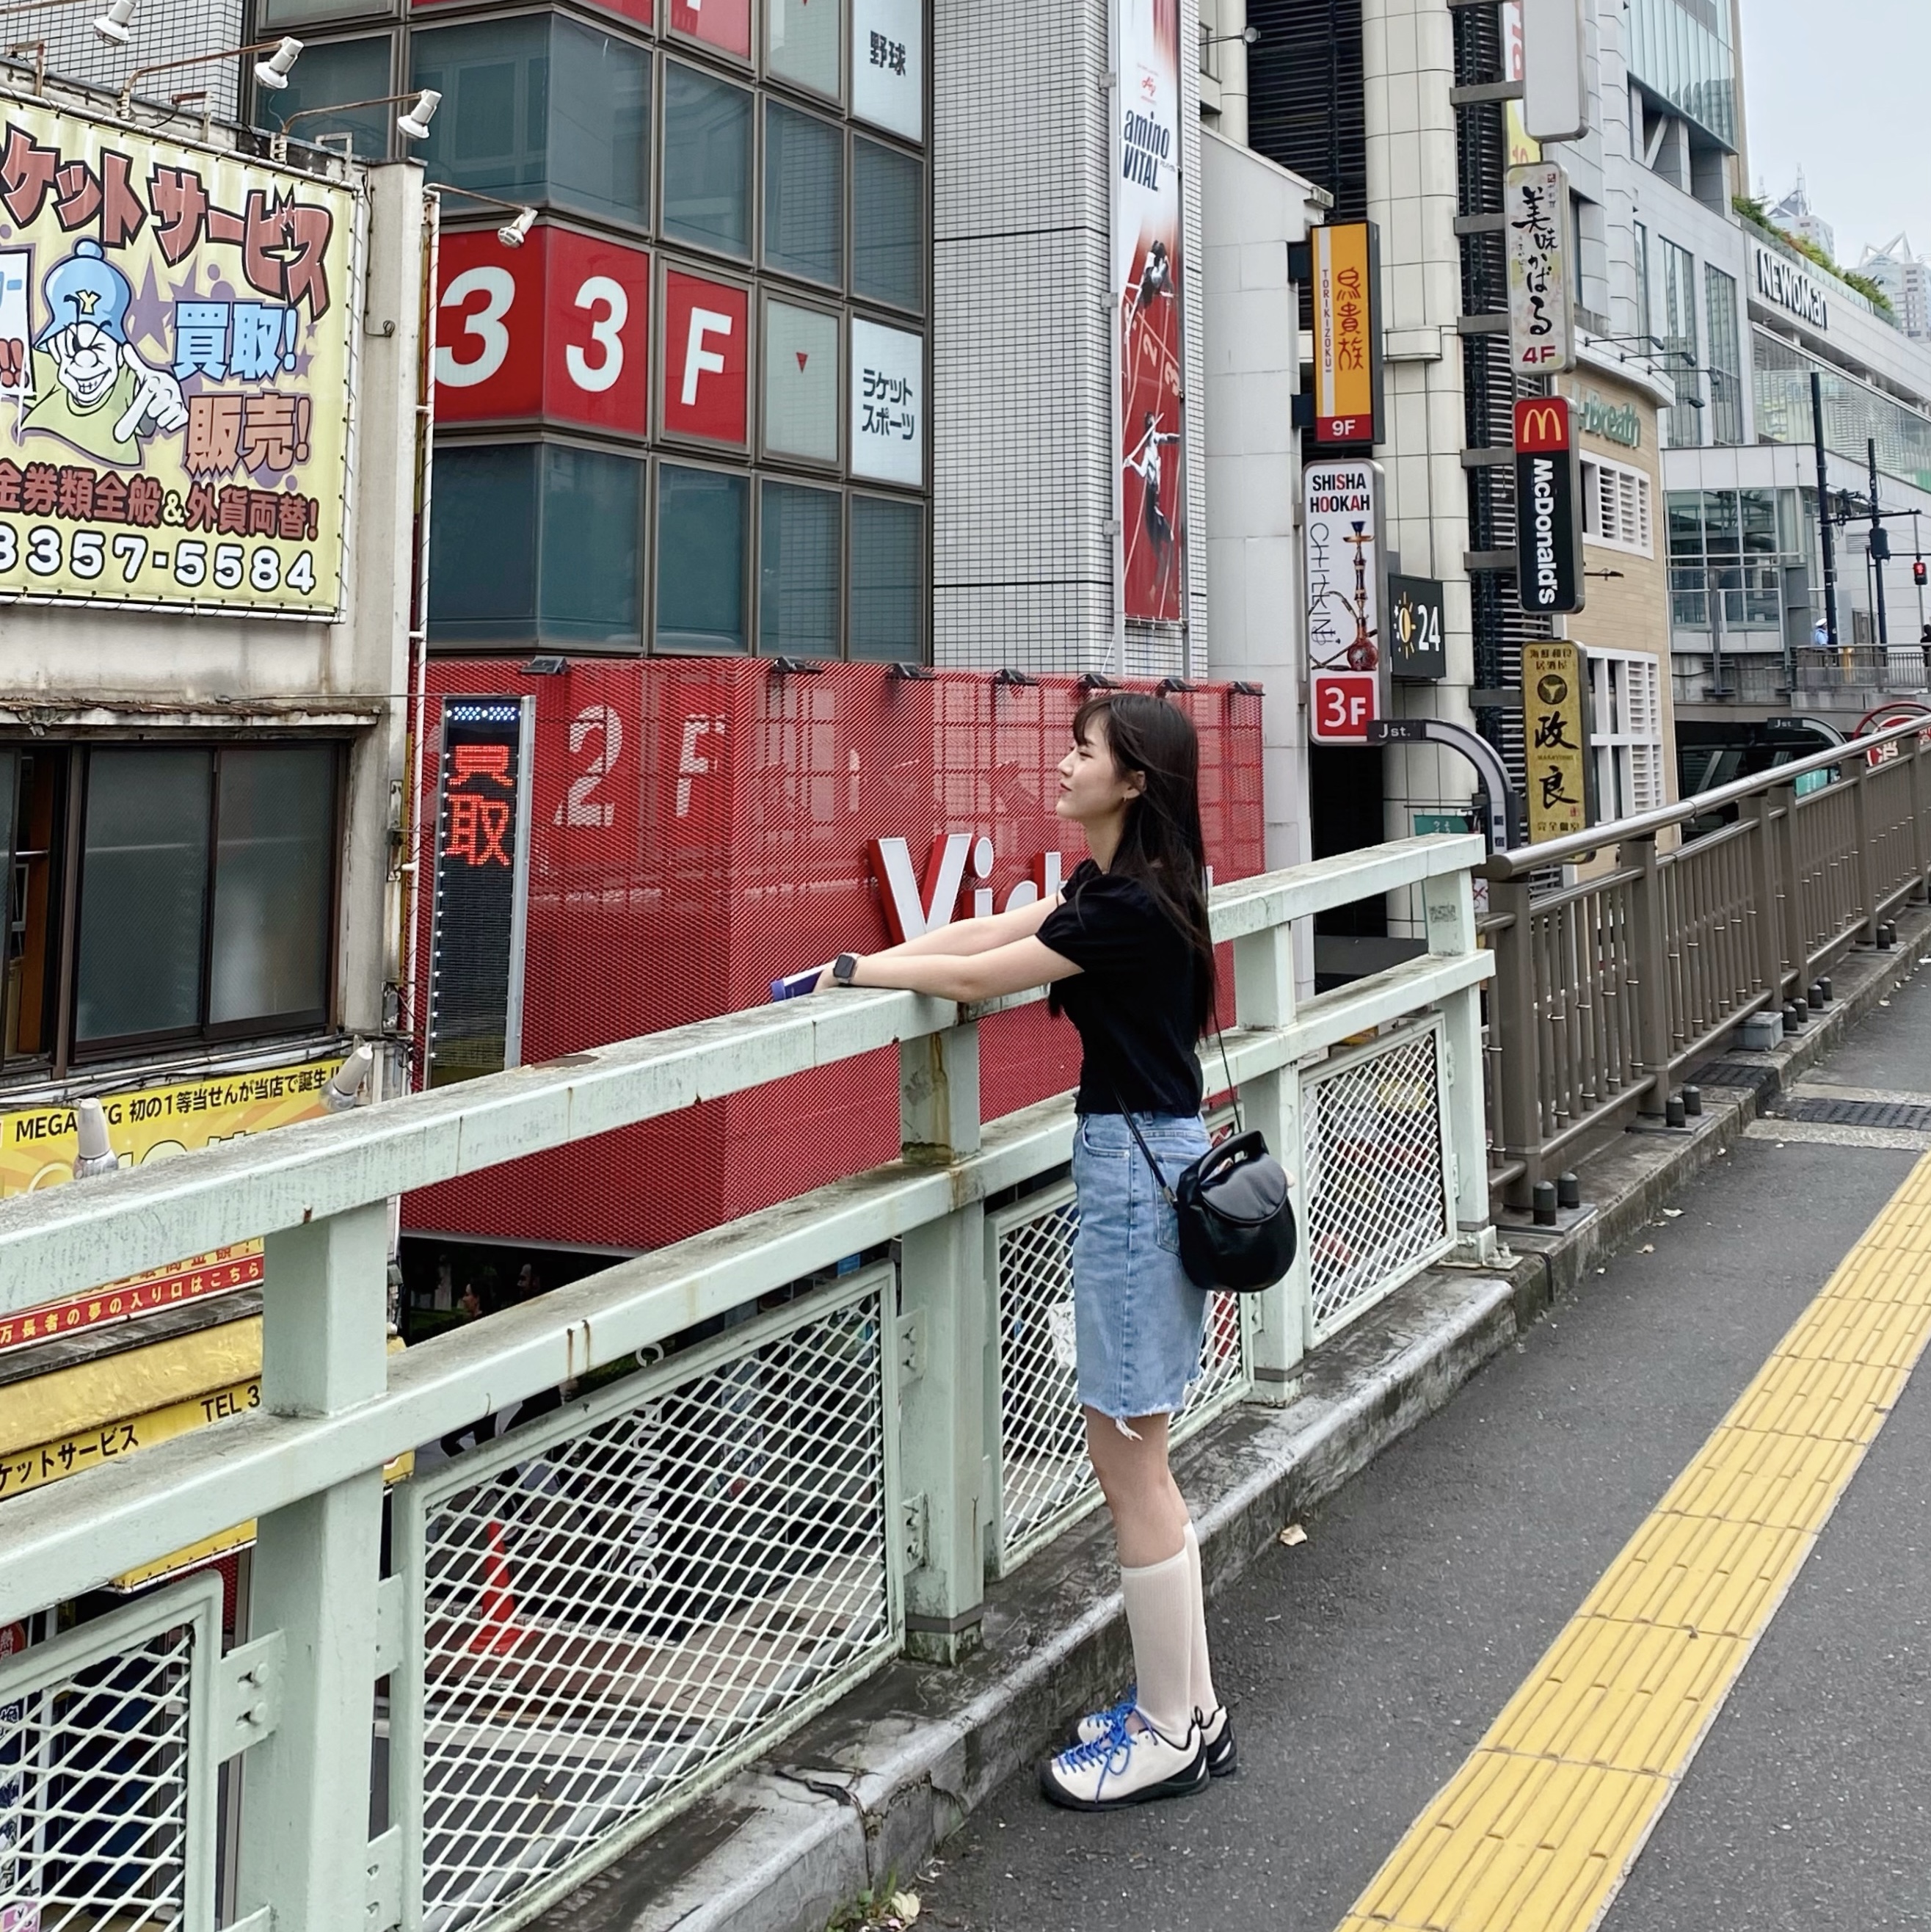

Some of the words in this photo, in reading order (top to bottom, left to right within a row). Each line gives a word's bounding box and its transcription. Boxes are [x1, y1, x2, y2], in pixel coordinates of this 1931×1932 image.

[870, 29, 906, 76] 野球
[1124, 109, 1170, 159] amino
[1123, 143, 1159, 192] VITAL
[1522, 346, 1555, 364] 4F
[862, 368, 912, 405] ラケット
[862, 404, 914, 440] スポーツ
[1332, 420, 1356, 437] 9F
[1312, 473, 1367, 491] SHISHA
[1310, 494, 1370, 512] HOOKAH
[1533, 458, 1557, 605] McDonald's
[1417, 604, 1441, 652] 24
[1324, 686, 1367, 727] 3F
[200, 1392, 242, 1423] TEL
